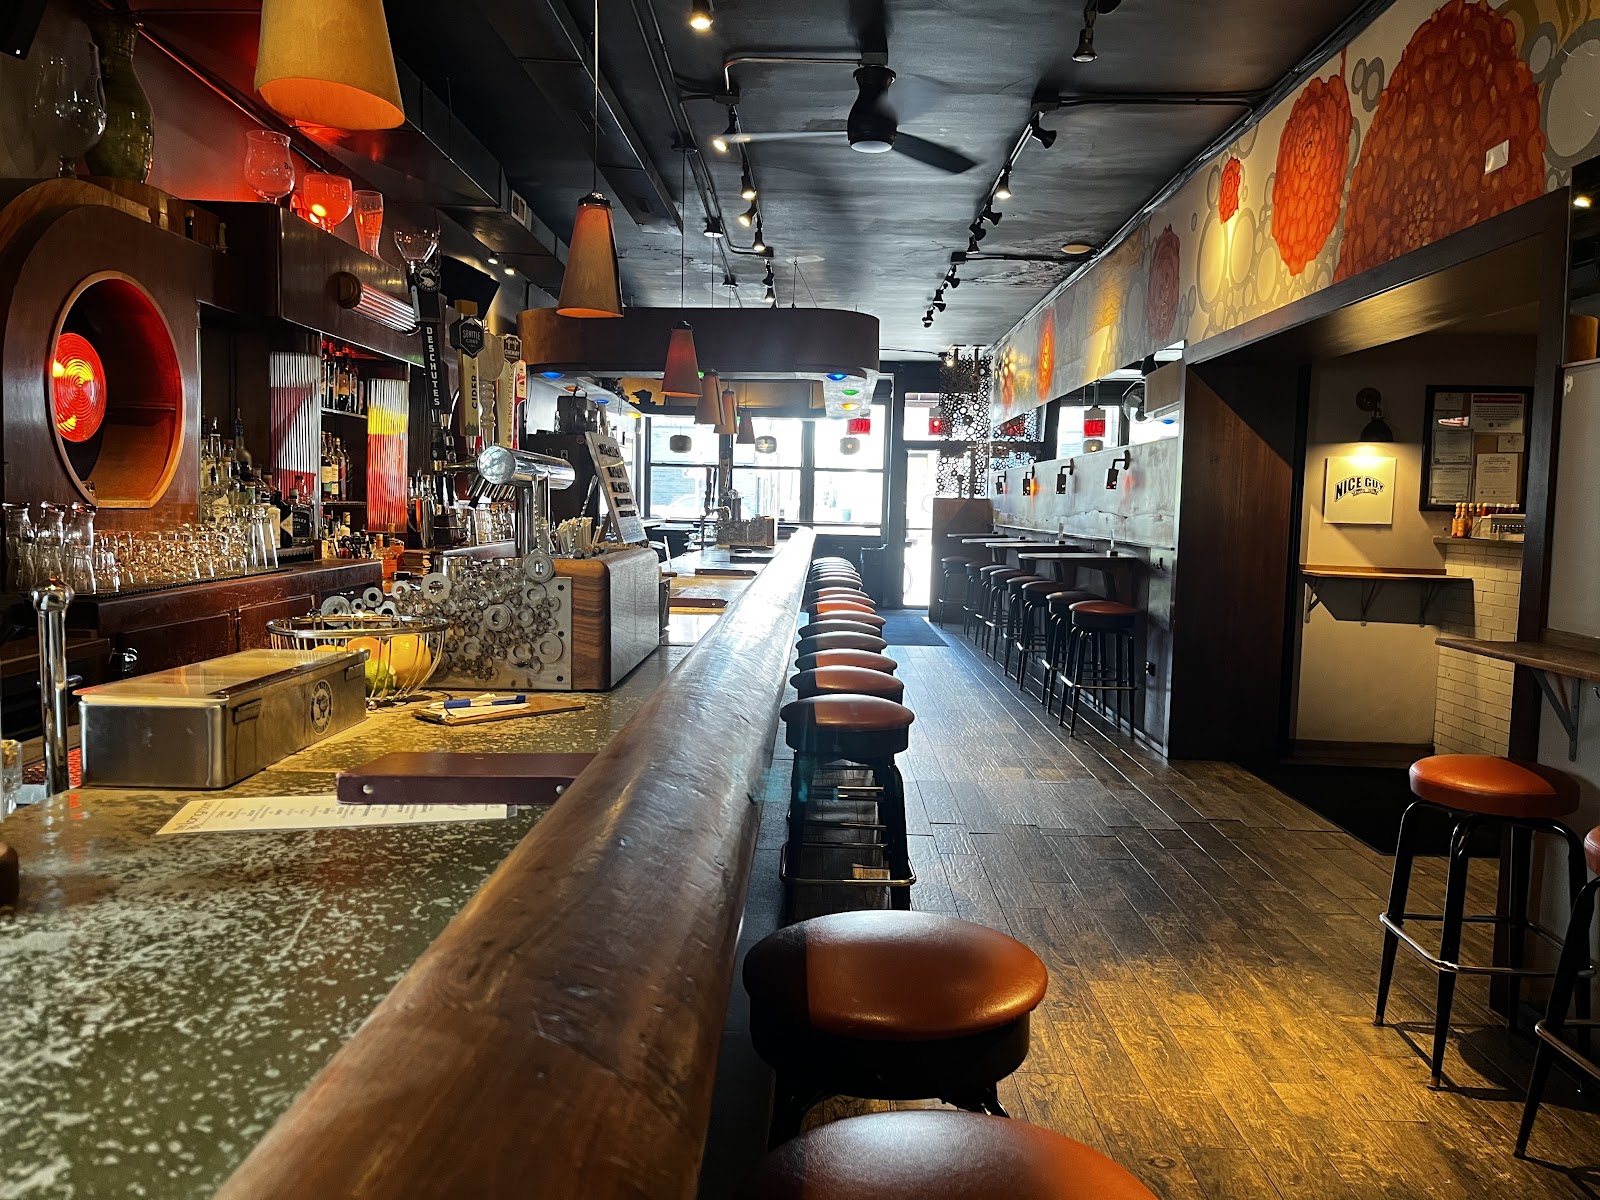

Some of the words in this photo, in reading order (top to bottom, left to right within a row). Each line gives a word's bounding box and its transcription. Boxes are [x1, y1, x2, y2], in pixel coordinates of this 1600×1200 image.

[463, 329, 481, 340] SEATTLE
[426, 326, 440, 406] DESCHUTES
[1335, 476, 1362, 501] NICE
[1364, 477, 1384, 491] GUY
